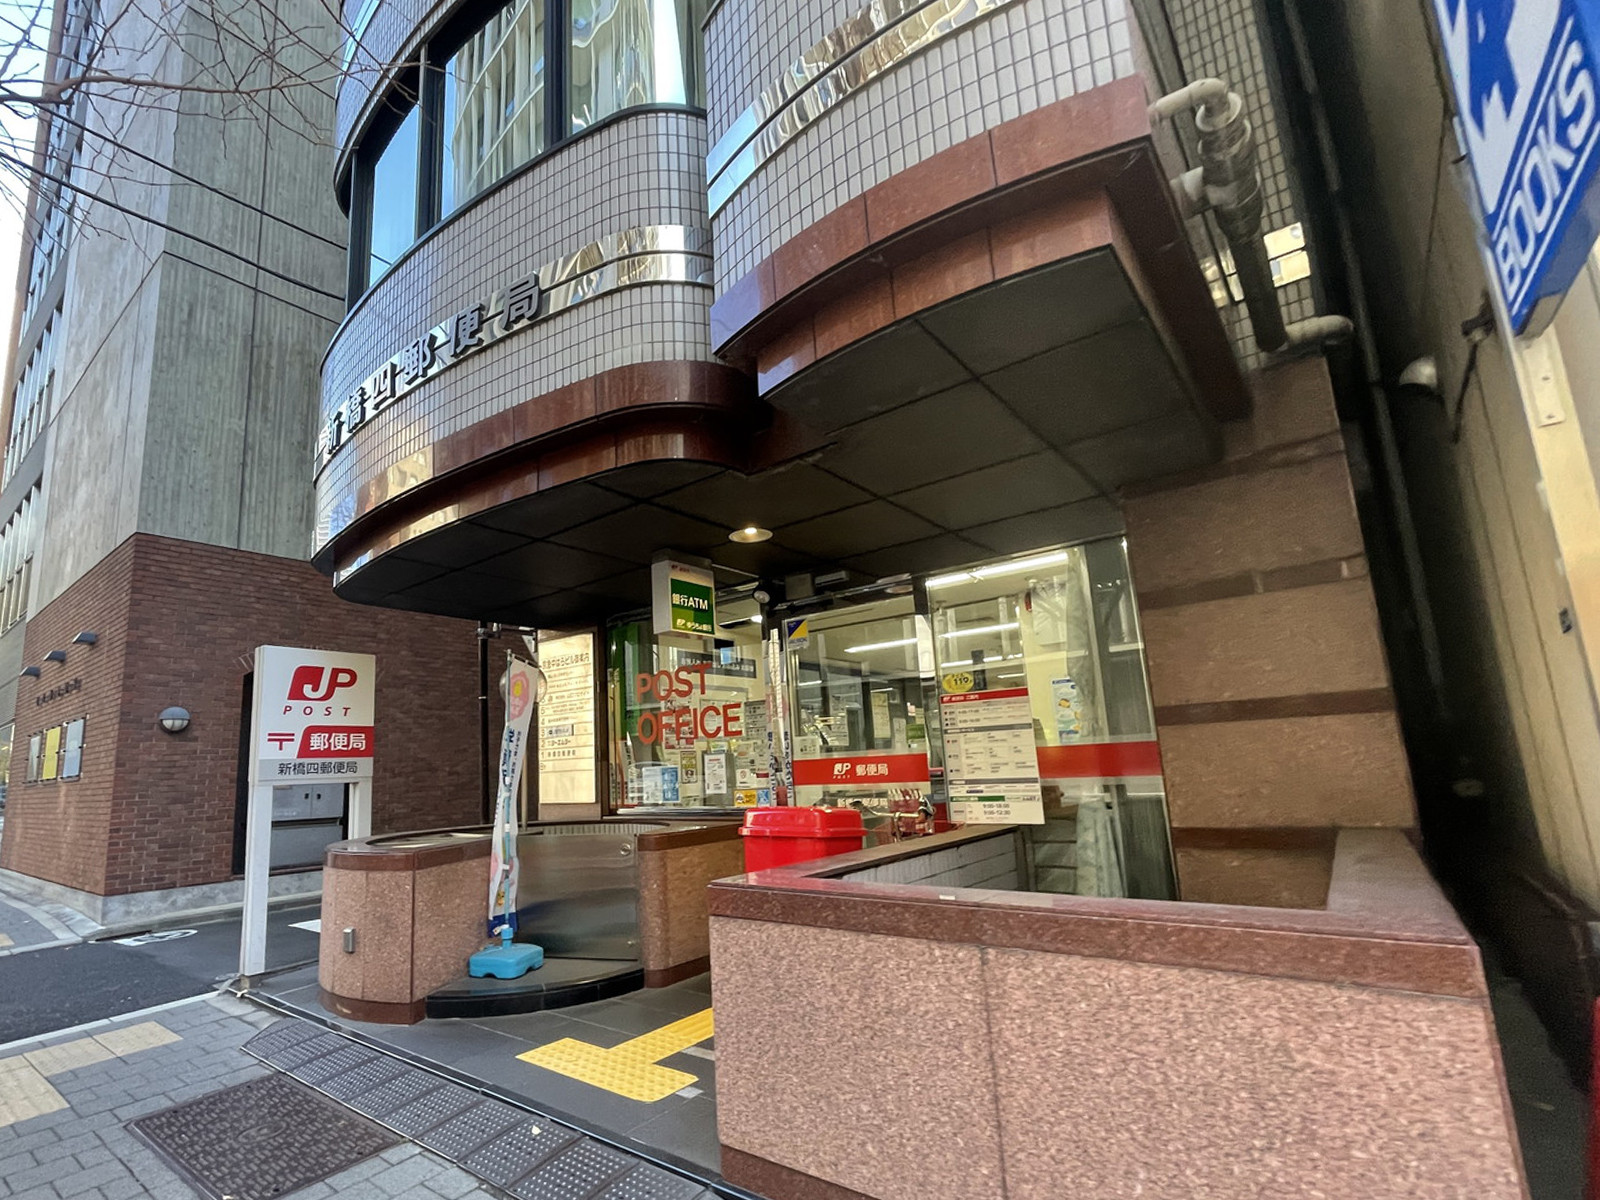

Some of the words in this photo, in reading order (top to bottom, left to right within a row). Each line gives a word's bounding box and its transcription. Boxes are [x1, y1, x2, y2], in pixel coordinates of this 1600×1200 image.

[1494, 40, 1597, 304] BOOKS
[672, 592, 708, 611] 銀行ATM
[287, 665, 358, 702] JP
[636, 663, 713, 704] POST
[283, 705, 351, 717] POST
[638, 703, 743, 745] OFFICE
[310, 732, 366, 751] 郵便局
[277, 760, 358, 776] 新橋四郵便局
[856, 763, 888, 777] 郵便局
